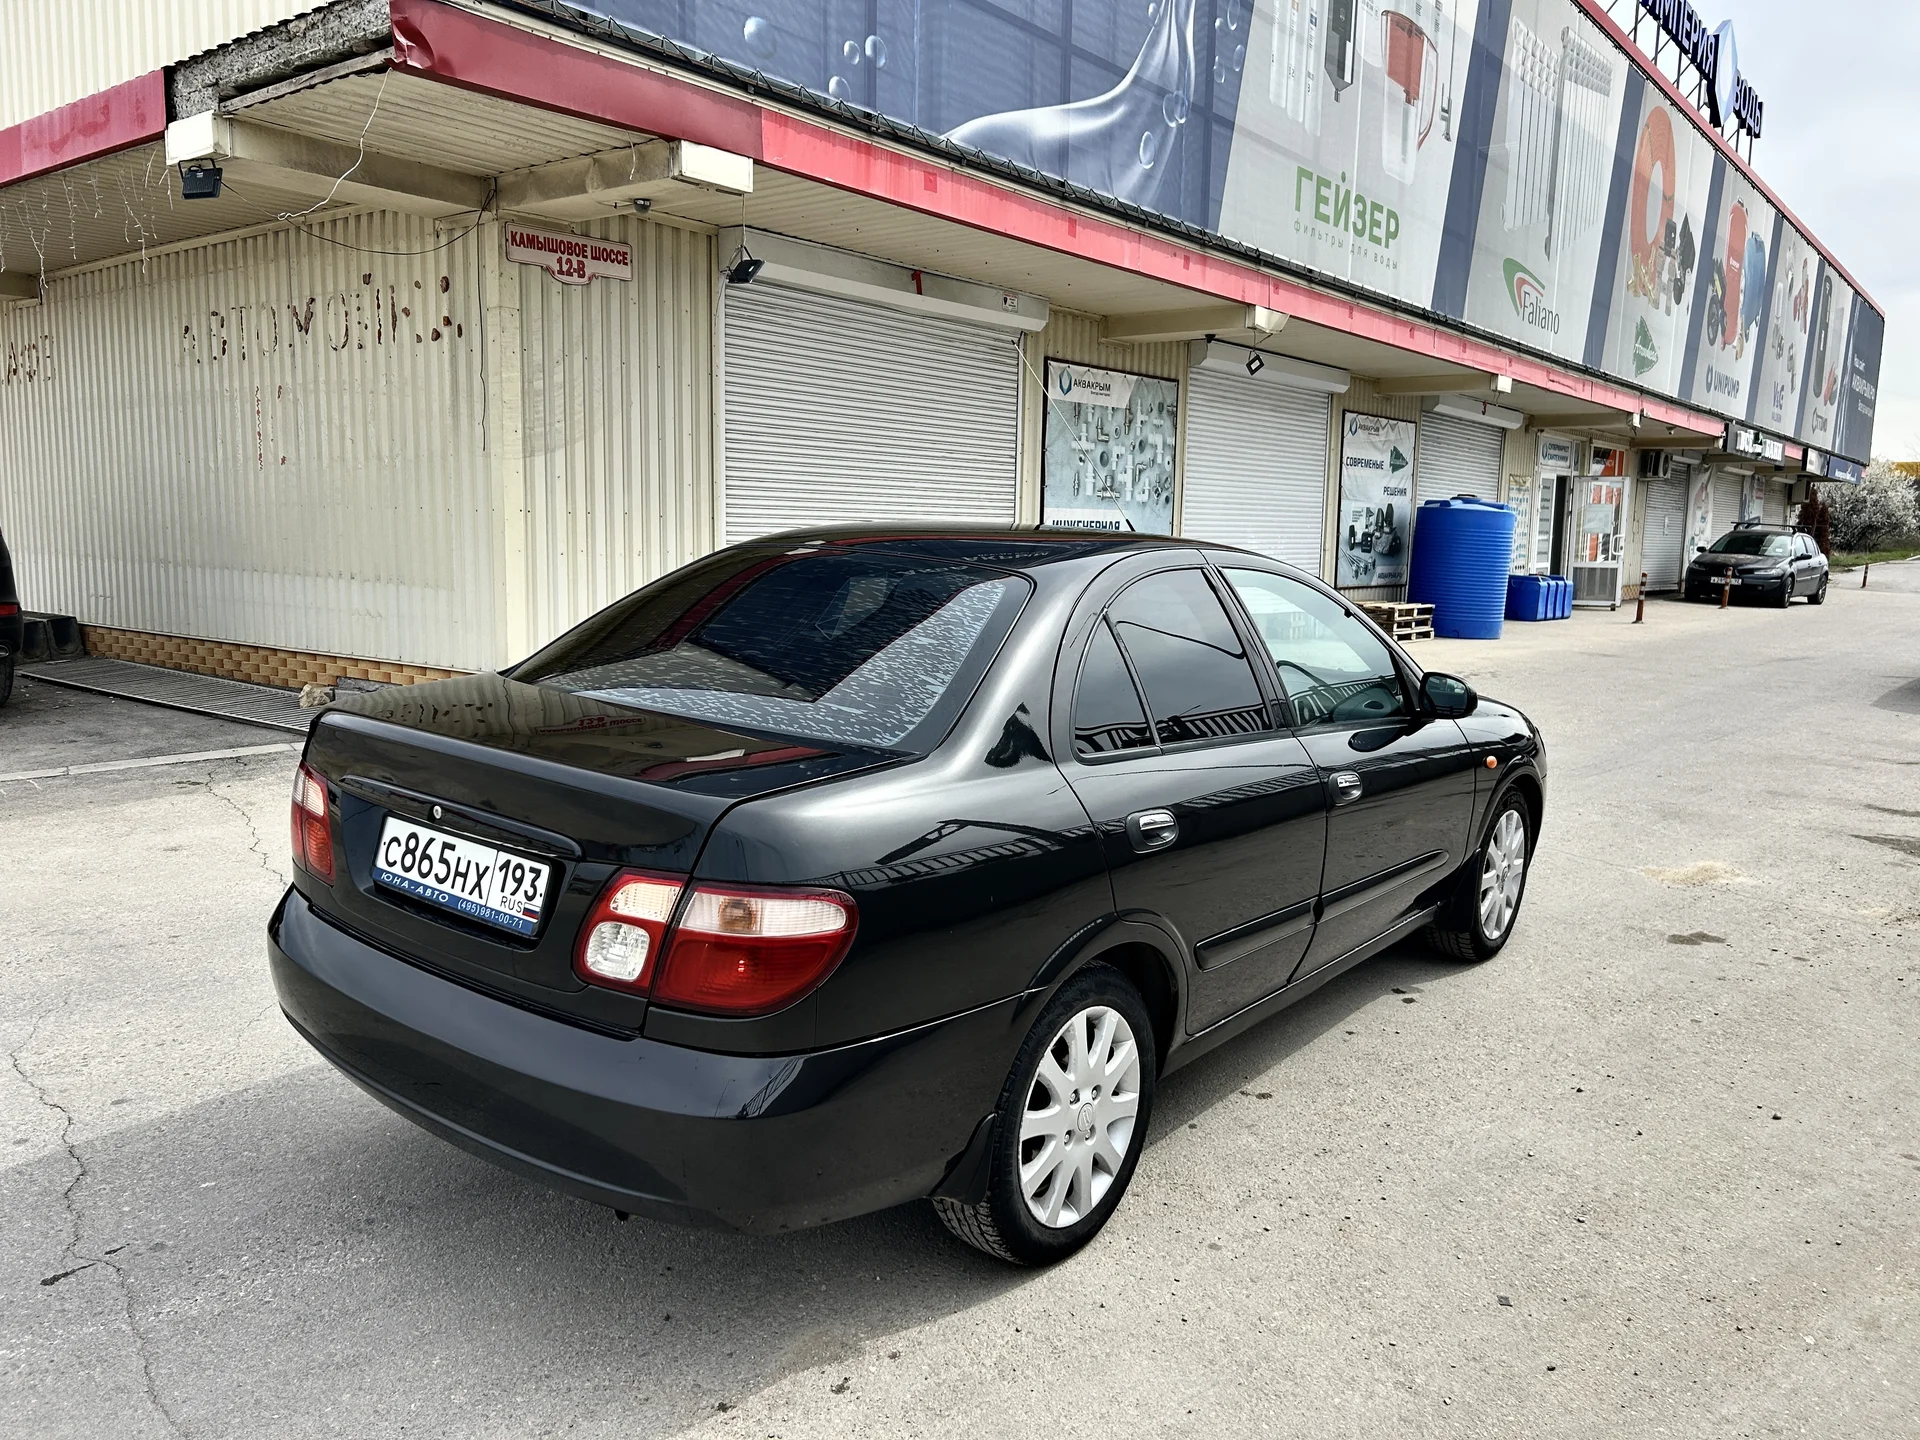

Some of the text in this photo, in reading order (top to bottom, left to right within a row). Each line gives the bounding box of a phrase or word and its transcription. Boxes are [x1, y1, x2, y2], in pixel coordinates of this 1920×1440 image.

[1645, 0, 1763, 138] МПЕРИЯ ВОДЫ
[1295, 166, 1399, 249] ГЕЙЗЕР
[510, 231, 629, 266] КАМЫШОВОЕ ШОССЕ
[1374, 252, 1398, 269] воды
[556, 256, 586, 279] 12-В
[1522, 291, 1560, 334] Faliano
[1073, 379, 1111, 392] АКВАКРЫМ
[1714, 370, 1739, 399] UNIPUMP
[498, 858, 542, 902] 193
[381, 872, 523, 929] ЮНА-АВТО (495)981-00-71
[499, 895, 523, 914] RUS
